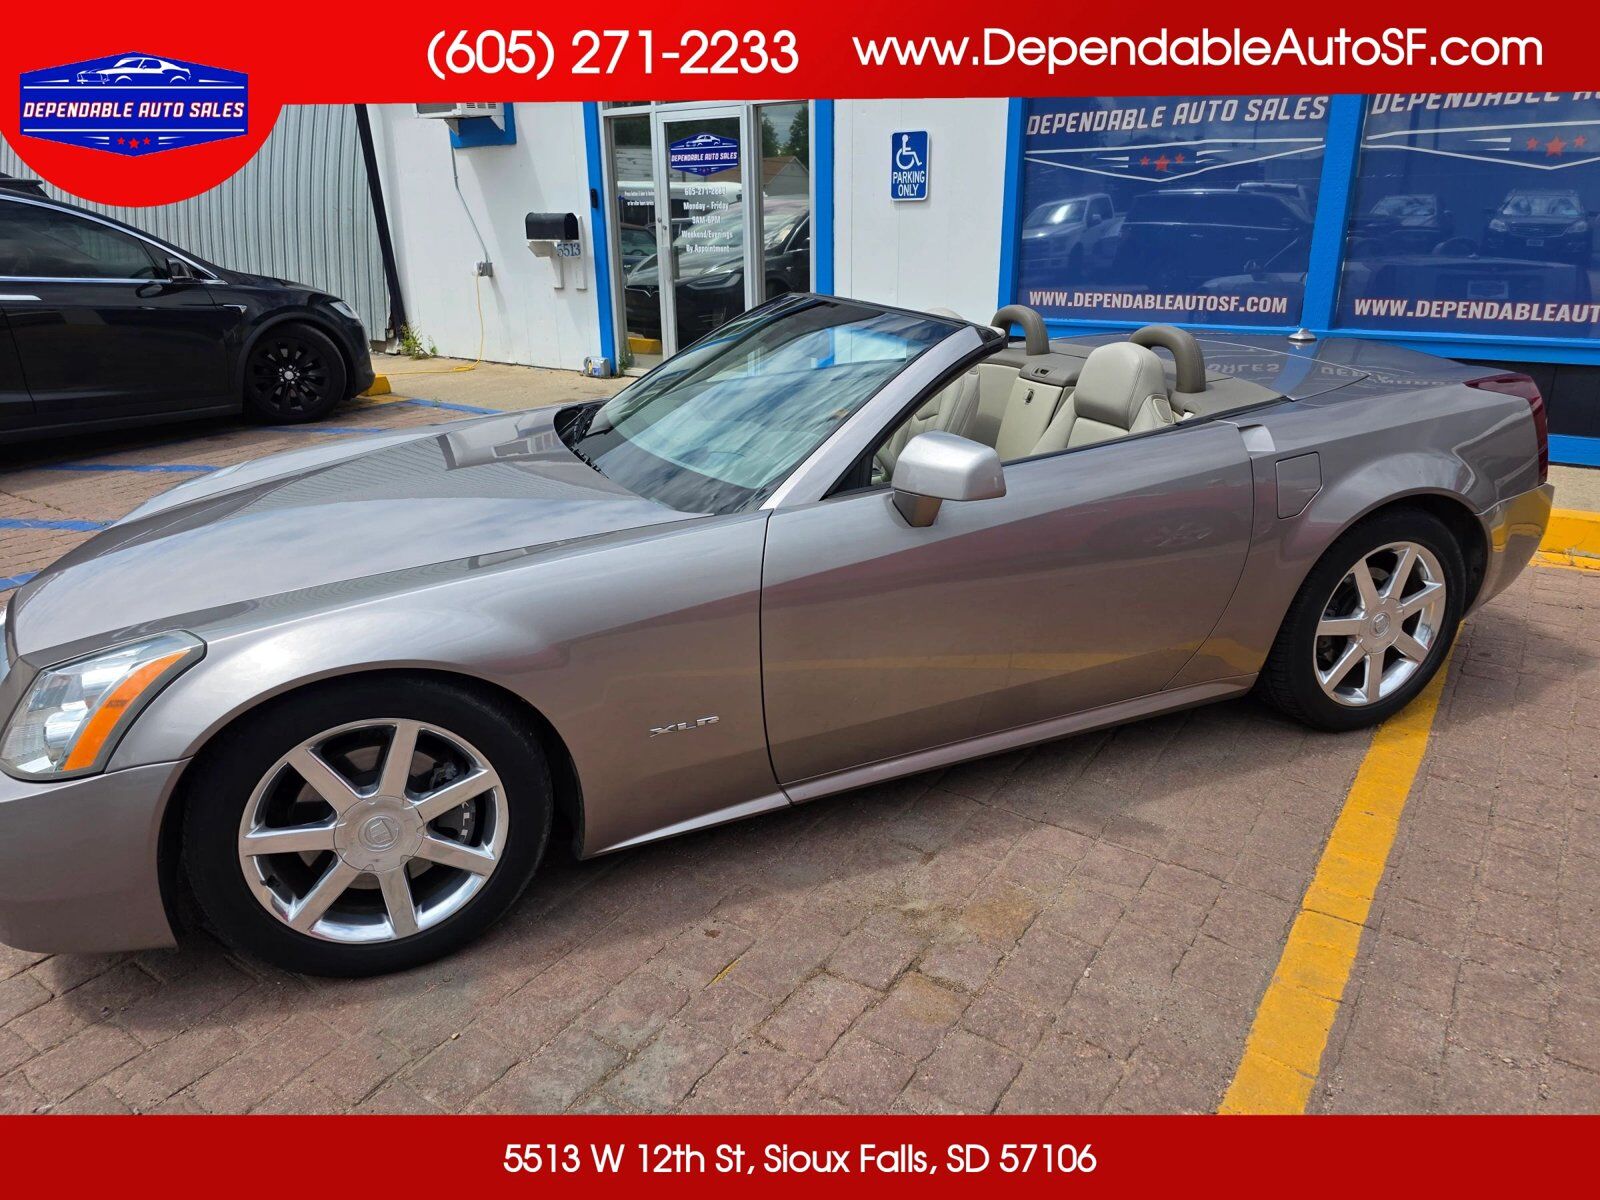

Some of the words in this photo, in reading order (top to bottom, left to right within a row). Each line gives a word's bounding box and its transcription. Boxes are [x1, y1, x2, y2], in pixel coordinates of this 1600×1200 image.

[1026, 106, 1167, 136] DEPENDABLE
[1172, 99, 1239, 125] AUTO
[1244, 96, 1329, 121] SALES
[671, 153, 704, 162] DEPENDABLE
[704, 152, 719, 161] AUTO
[719, 152, 738, 160] SALES
[892, 170, 925, 185] PARKING
[897, 184, 919, 197] ONLY
[683, 201, 706, 212] Monday
[711, 201, 729, 212] Friday
[557, 243, 581, 257] 5513
[686, 244, 694, 254] By
[694, 243, 730, 254] Appointment
[1029, 291, 1288, 314] WWW.DEPENDABLEAUTOSF.COM
[1354, 299, 1600, 323] WWW.DEPENDABLEAUT
[649, 715, 720, 738] XLR
